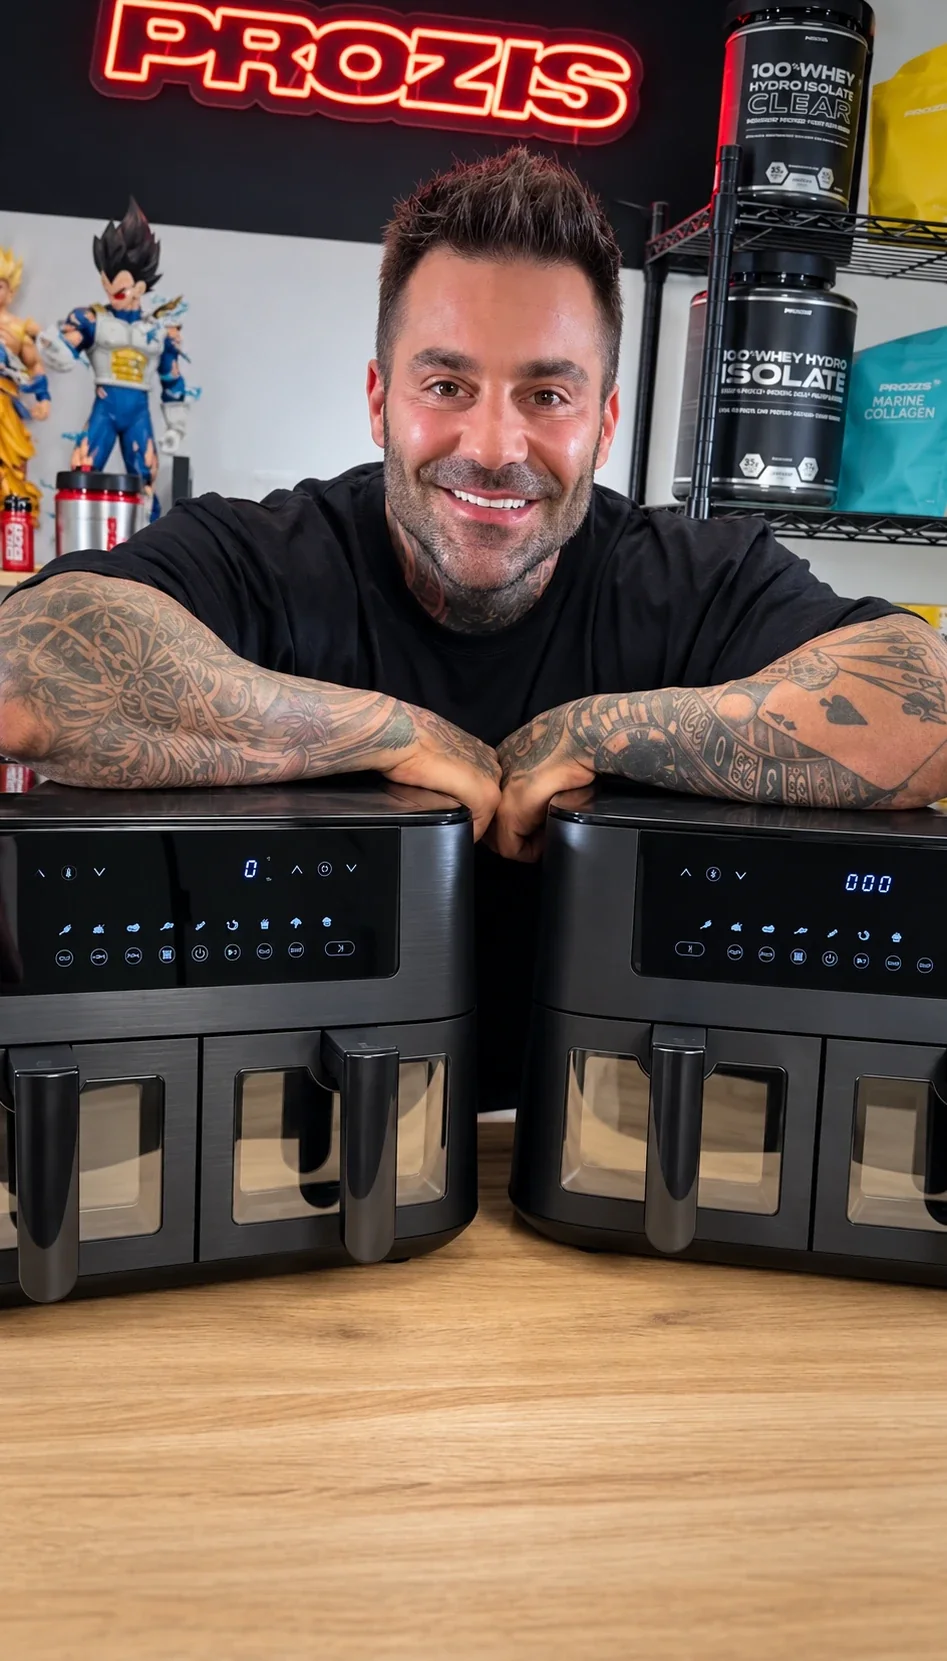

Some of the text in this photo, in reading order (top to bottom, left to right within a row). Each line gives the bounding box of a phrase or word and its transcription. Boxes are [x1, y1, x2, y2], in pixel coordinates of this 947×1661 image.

[103, 0, 632, 128] PROZIS
[749, 80, 854, 101] HYDRO ISOLATE
[748, 93, 852, 125] CLEAR
[806, 353, 847, 370] HYDRO
[721, 363, 846, 393] ISOLATE
[872, 395, 925, 407] MARINE
[864, 407, 936, 420] COLLAGEN
[244, 859, 258, 878] 0
[845, 872, 893, 894] 000
